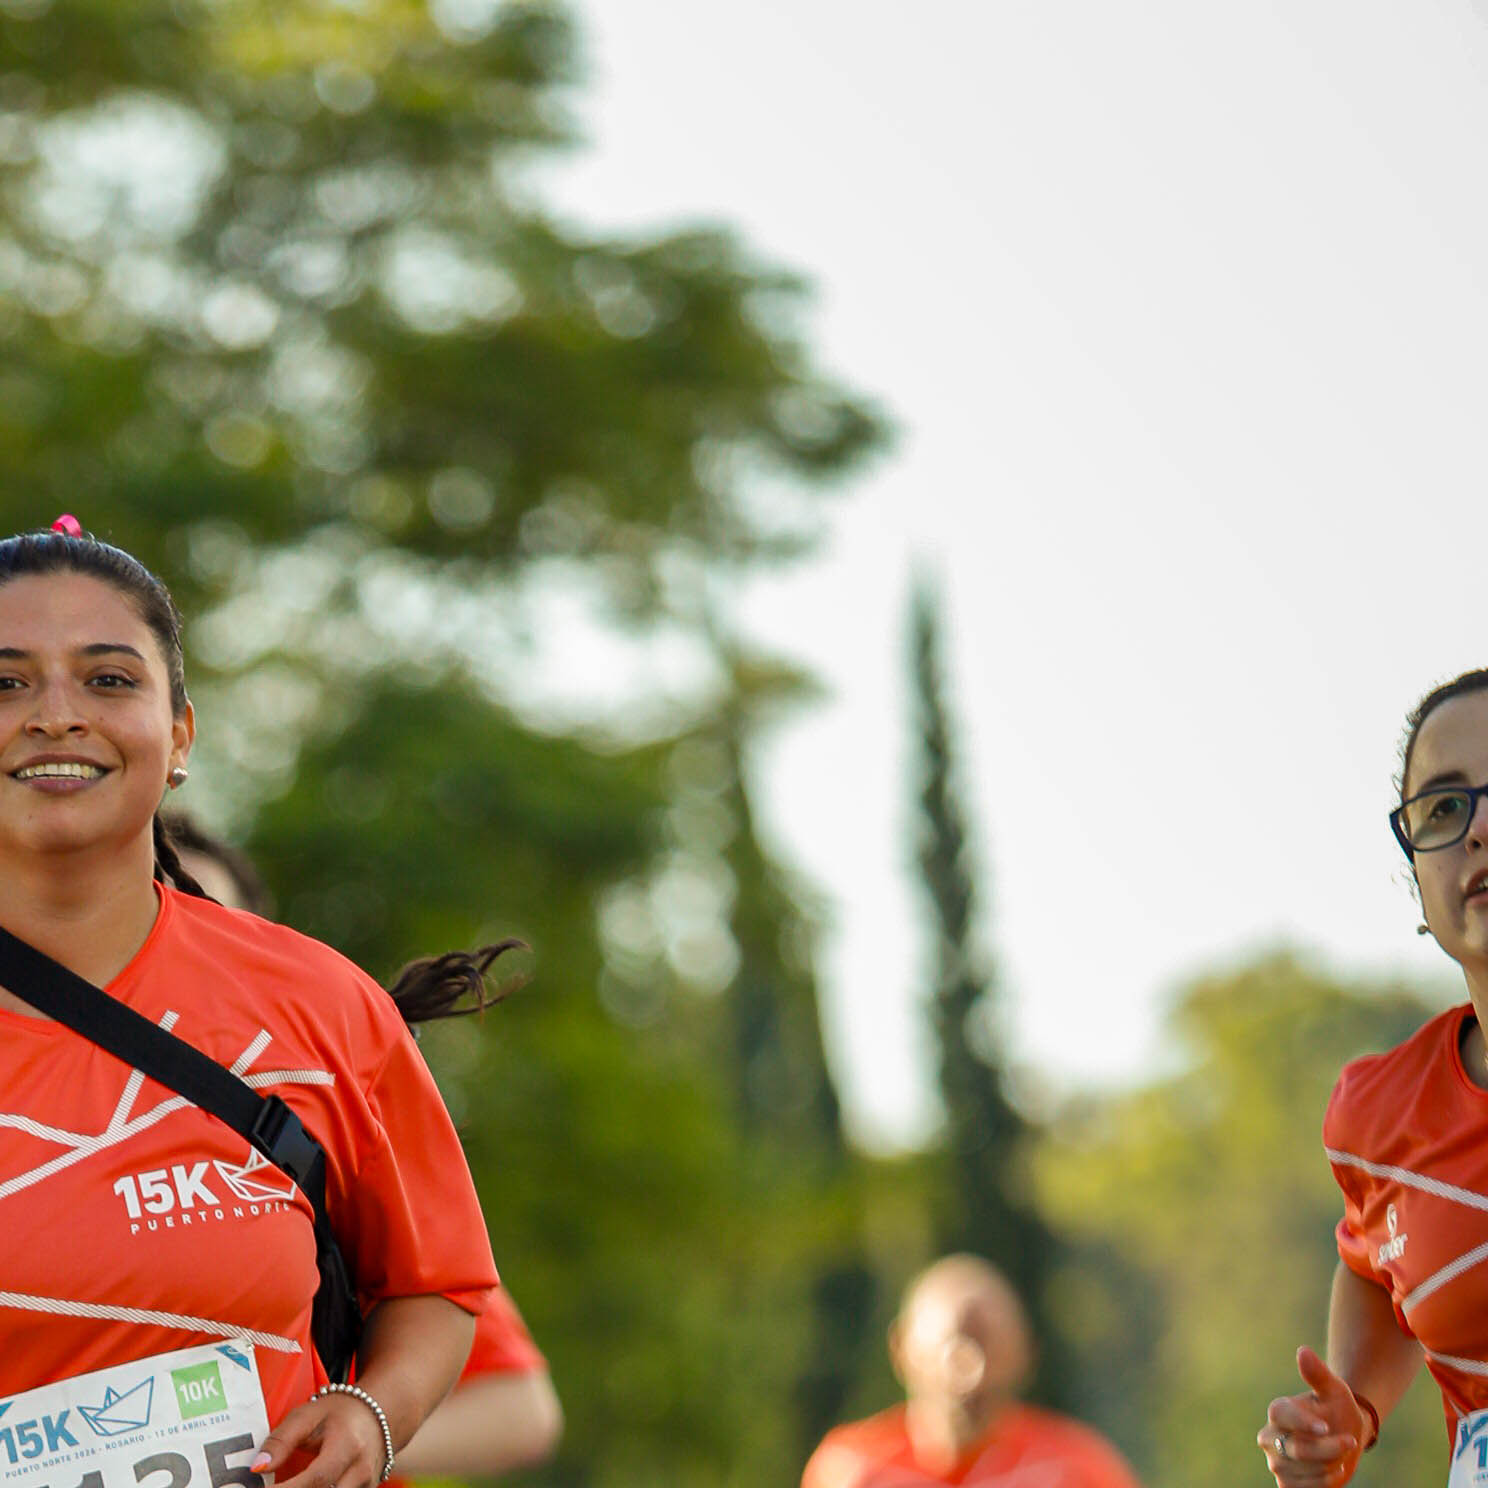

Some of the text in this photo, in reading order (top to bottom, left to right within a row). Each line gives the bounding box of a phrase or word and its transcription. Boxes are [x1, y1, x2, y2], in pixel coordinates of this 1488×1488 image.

[113, 1161, 221, 1219] 15K
[130, 1208, 224, 1236] PUERTO
[179, 1376, 220, 1404] 10K
[5, 1463, 40, 1480] PUERTO
[42, 1453, 72, 1468] NORTE
[74, 1446, 96, 1459] 2026
[105, 1434, 145, 1451] ROSARIO
[167, 1424, 179, 1435] DE
[182, 1420, 208, 1432] ABRIL
[210, 1413, 231, 1425] 2026
